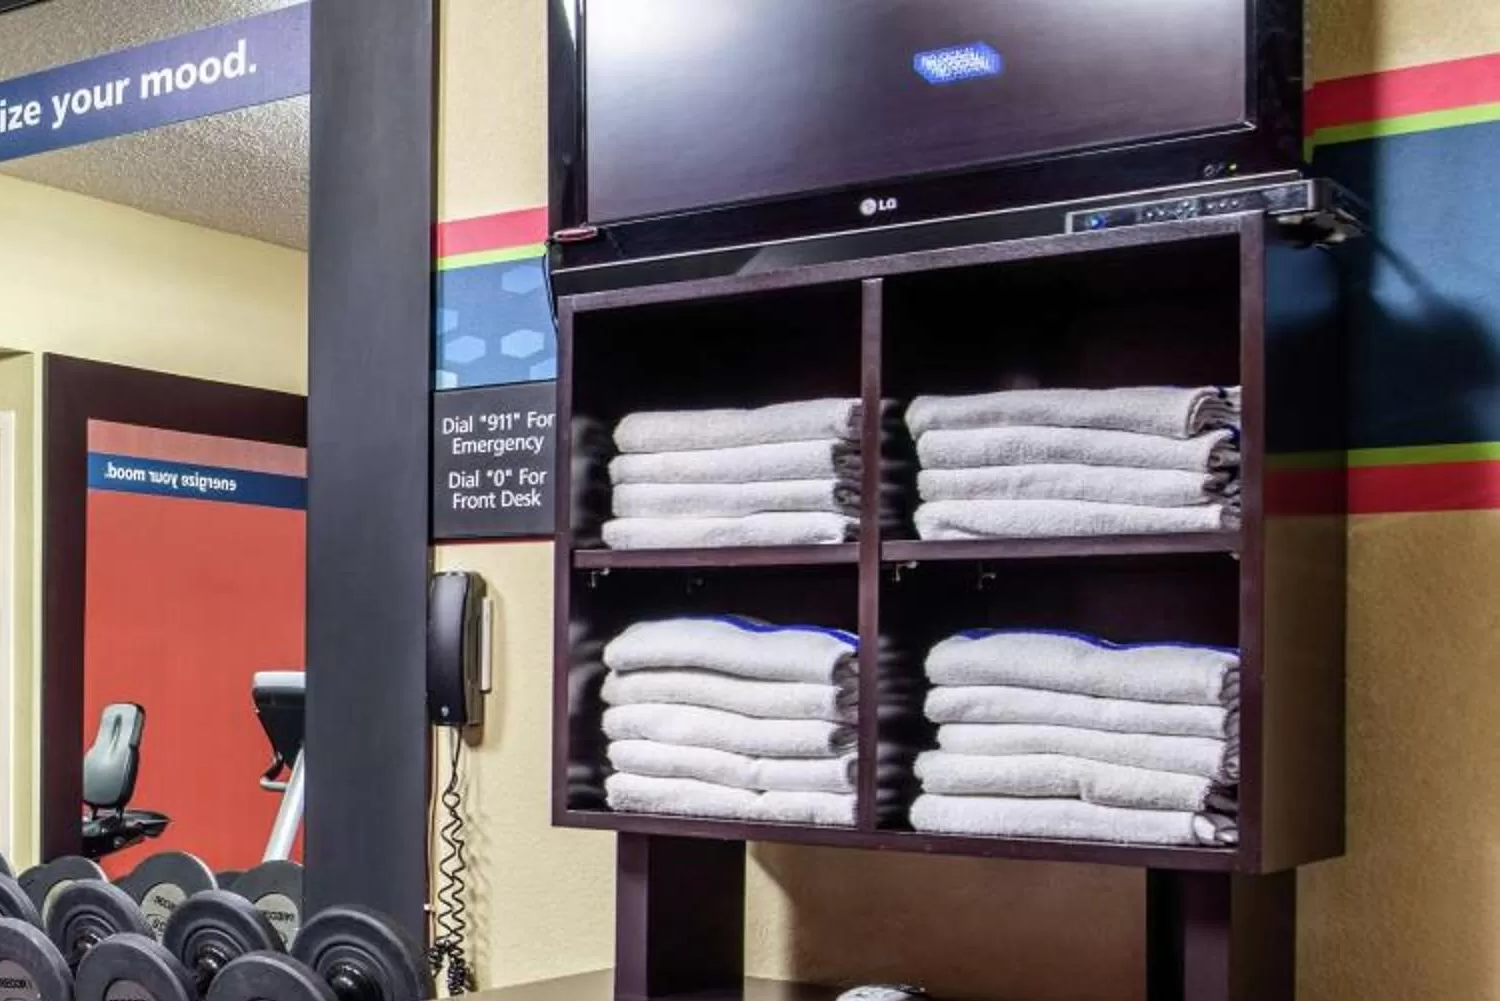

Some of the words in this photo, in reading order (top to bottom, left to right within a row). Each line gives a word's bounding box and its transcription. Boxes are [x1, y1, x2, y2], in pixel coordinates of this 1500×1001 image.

[51, 78, 131, 129] your
[139, 39, 257, 99] mood.
[878, 197, 898, 211] LG
[442, 415, 474, 435] Dial
[479, 412, 521, 431] "911"
[527, 411, 556, 429] For
[452, 436, 545, 457] Emergency
[448, 469, 480, 489] Dial
[518, 467, 548, 486] For
[452, 492, 497, 510] Front
[500, 488, 542, 508] Desk
